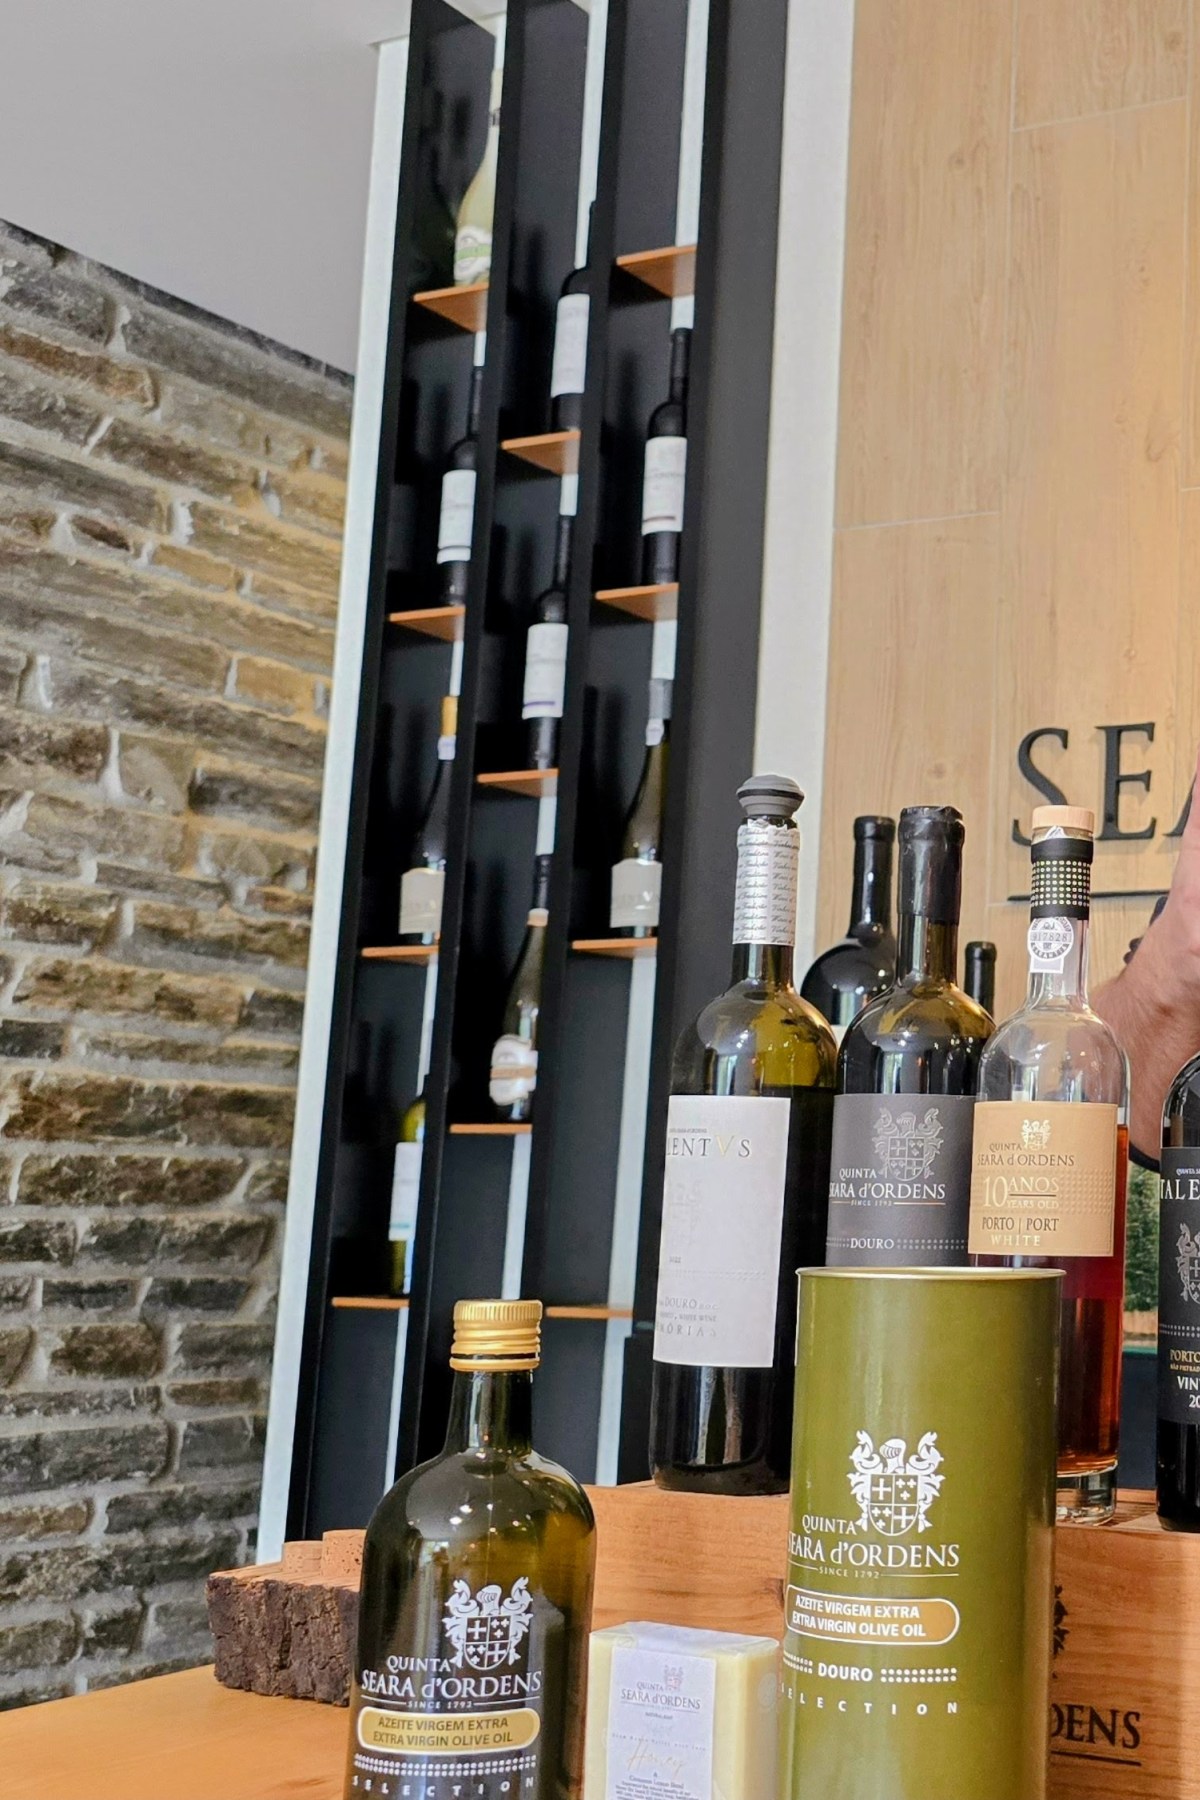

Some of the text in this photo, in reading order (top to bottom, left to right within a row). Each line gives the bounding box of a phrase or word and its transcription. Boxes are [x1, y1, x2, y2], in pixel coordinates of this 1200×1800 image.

[667, 1135, 750, 1158] LENTVS
[989, 1143, 1022, 1153] QUINTA
[977, 1154, 1004, 1166] SEARA
[839, 1168, 877, 1180] QUINTA
[829, 1182, 946, 1199] SEARA d'ORDENS
[982, 1176, 1060, 1208] 10 ANOS
[1007, 1200, 1060, 1209] YEARS OLD
[982, 1216, 1060, 1231] PORTO PORT
[850, 1238, 895, 1249] DOURO
[990, 1235, 1041, 1247] WHITE
[802, 1514, 857, 1535] QUINTA
[830, 1542, 960, 1568] d'ORDENS
[818, 1566, 880, 1579] SINCE 1792
[795, 1594, 920, 1618] AZEITE VIRGEM EXTRA
[792, 1610, 926, 1637] EXTRA VIRGIN OLIVE OIL
[386, 1655, 451, 1674] QUINTA
[818, 1662, 873, 1682] DOURO
[361, 1669, 542, 1699] SEARA d'ORDENS
[636, 1681, 664, 1692] QUINTA
[406, 1700, 441, 1709] SINCE
[620, 1688, 650, 1703] SEARA
[652, 1694, 702, 1710] d'ORDENS
[378, 1716, 508, 1732] AZEITE VIRGEM EXTRA
[373, 1731, 513, 1746] EXTRA VIRGIN OLIVE OIL
[352, 1775, 535, 1798] SELECTION
